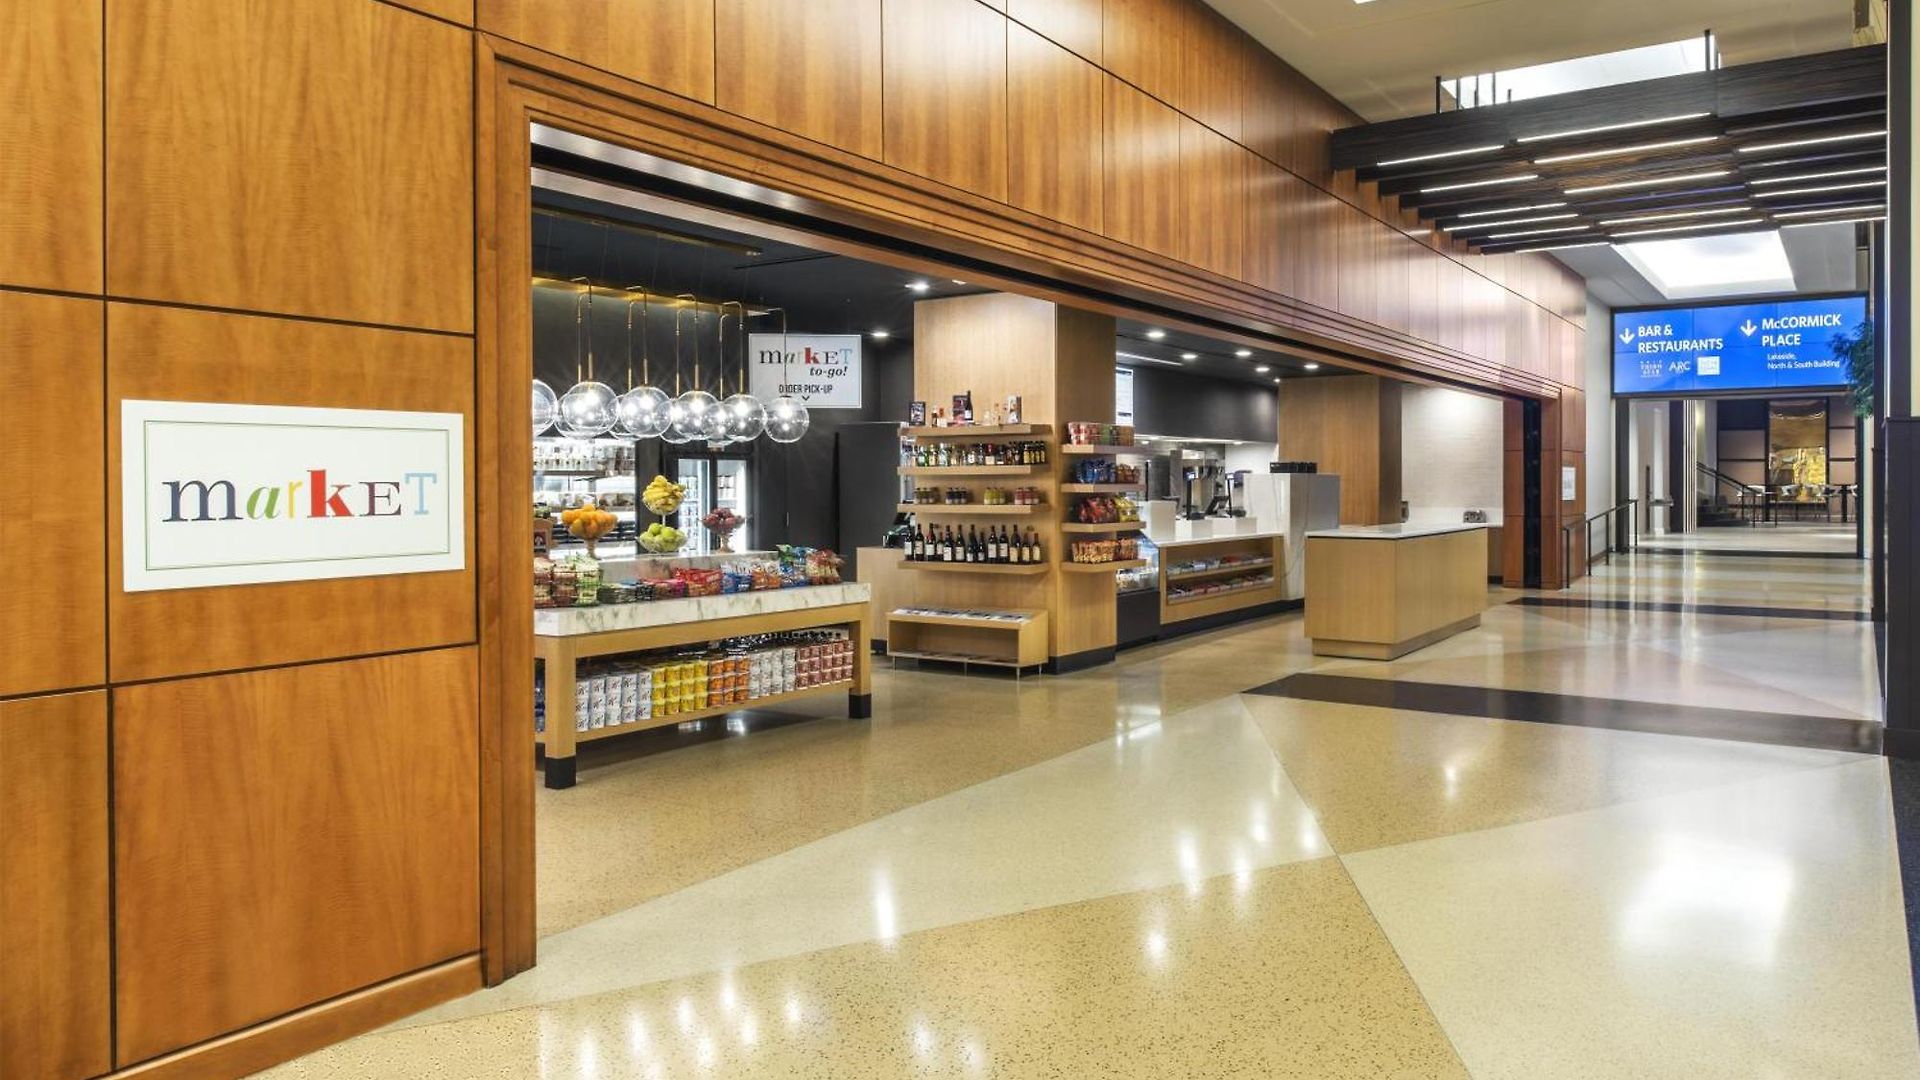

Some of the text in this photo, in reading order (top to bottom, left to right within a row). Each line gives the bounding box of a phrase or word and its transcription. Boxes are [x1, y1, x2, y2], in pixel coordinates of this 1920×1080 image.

[1761, 314, 1842, 331] McCORMICK
[1638, 324, 1673, 337] BAR &
[1638, 338, 1724, 353] RESTAURANTS
[1762, 333, 1801, 347] PLACE
[1669, 361, 1691, 372] ARC
[1767, 361, 1786, 370] North
[1793, 361, 1813, 369] South
[809, 366, 848, 378] to-go!
[804, 384, 833, 394] PICK-UP
